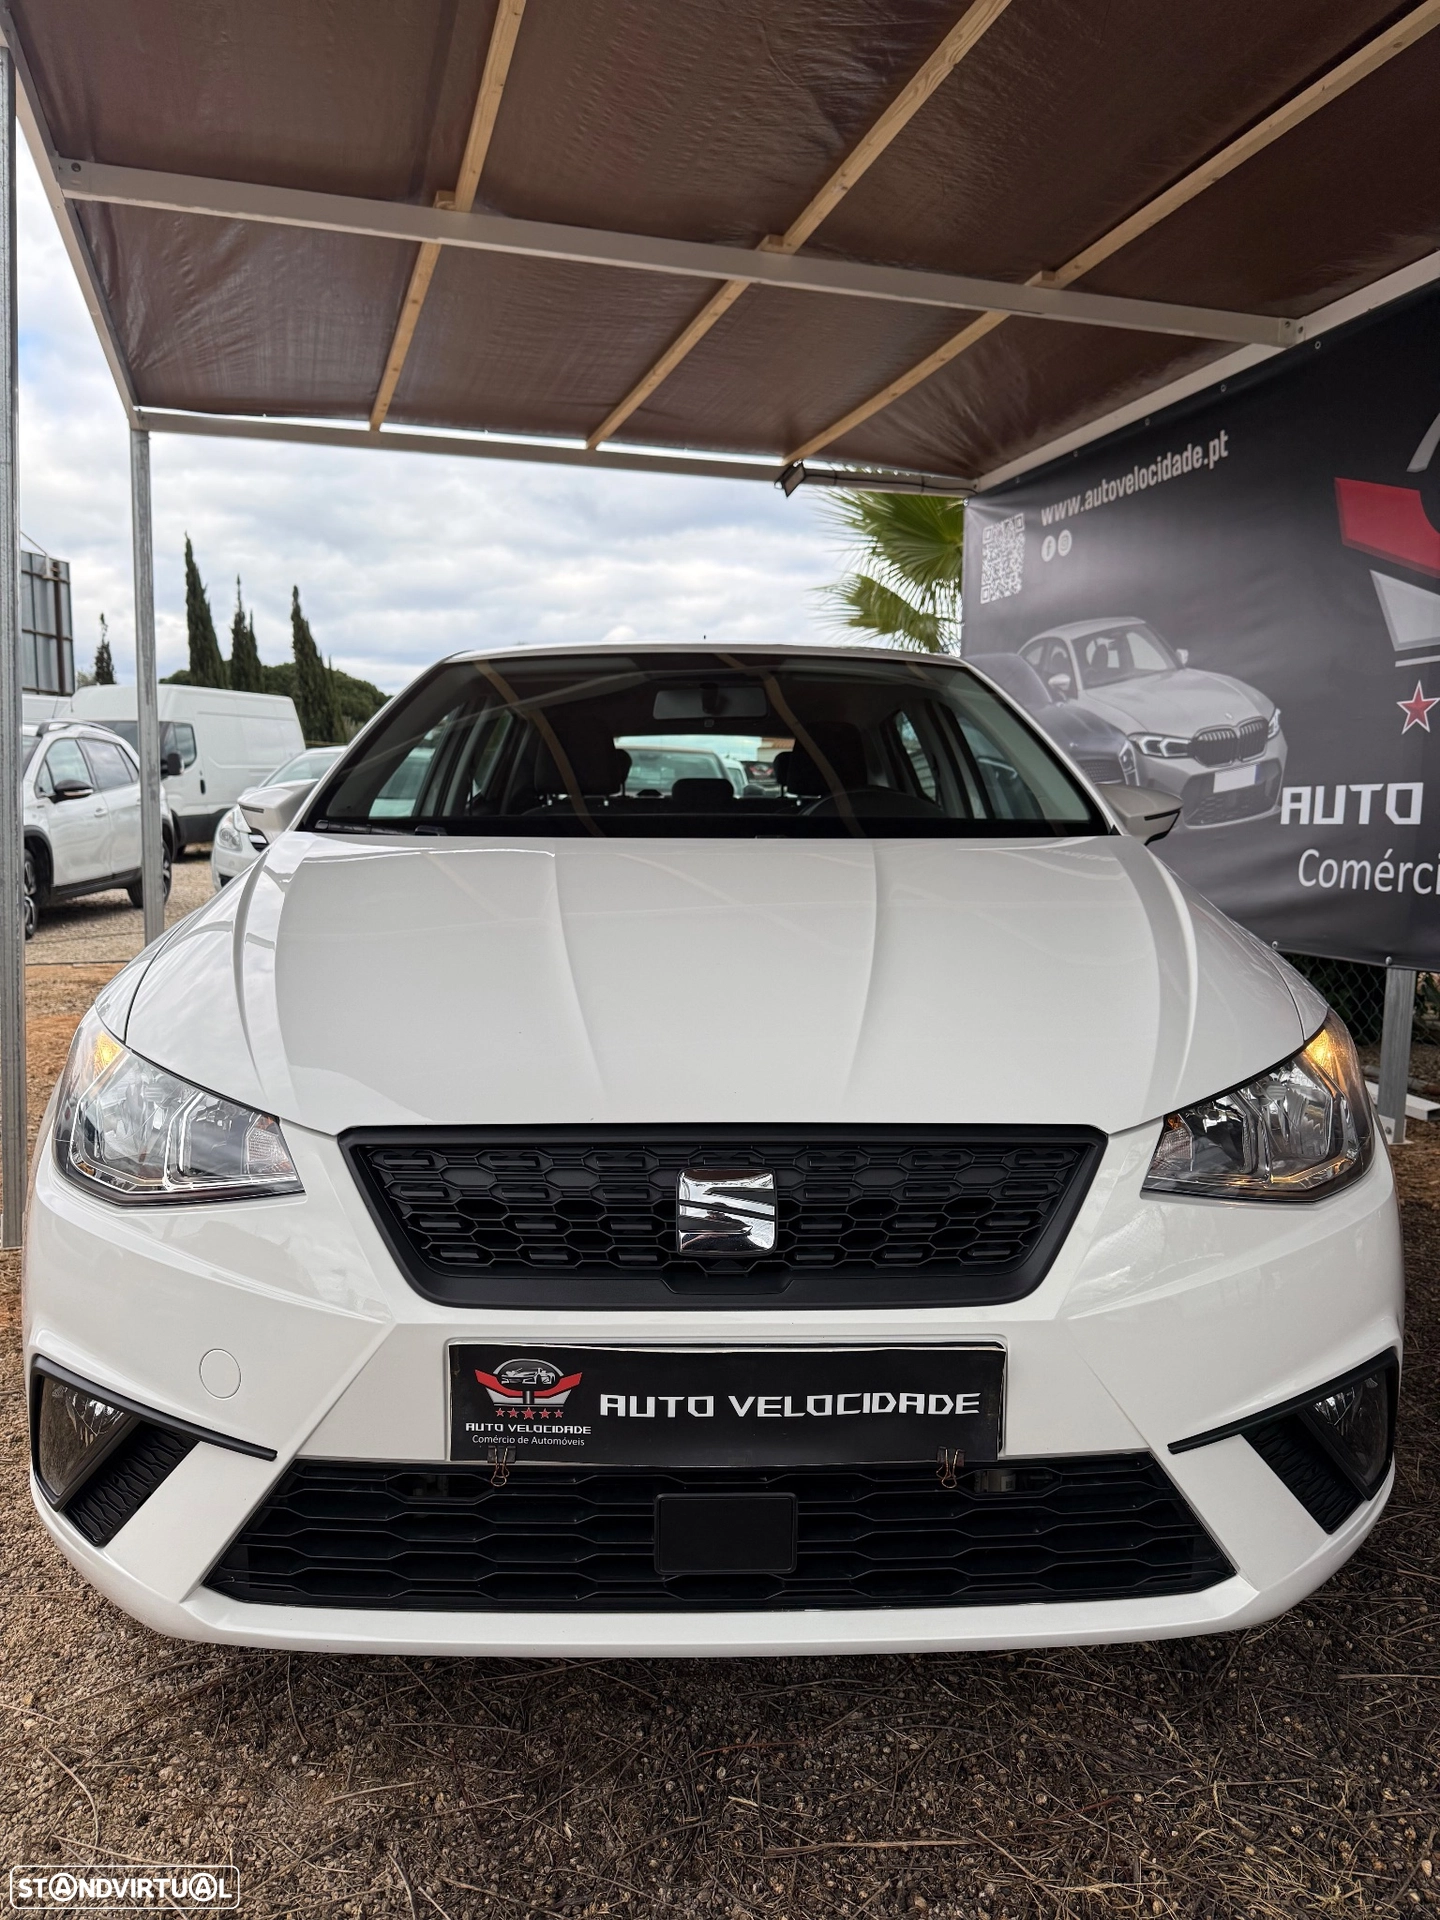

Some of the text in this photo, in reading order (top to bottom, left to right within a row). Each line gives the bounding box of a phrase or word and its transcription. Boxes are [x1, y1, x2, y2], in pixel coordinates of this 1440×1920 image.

[1041, 429, 1229, 527] www.autovelocidade.pt
[1280, 782, 1424, 825] AUTO
[600, 1392, 982, 1418] AUTO VELOCIDADE
[465, 1422, 591, 1434] AUTO VELOCIDADE
[472, 1434, 585, 1446] Comércio de Automóveis
